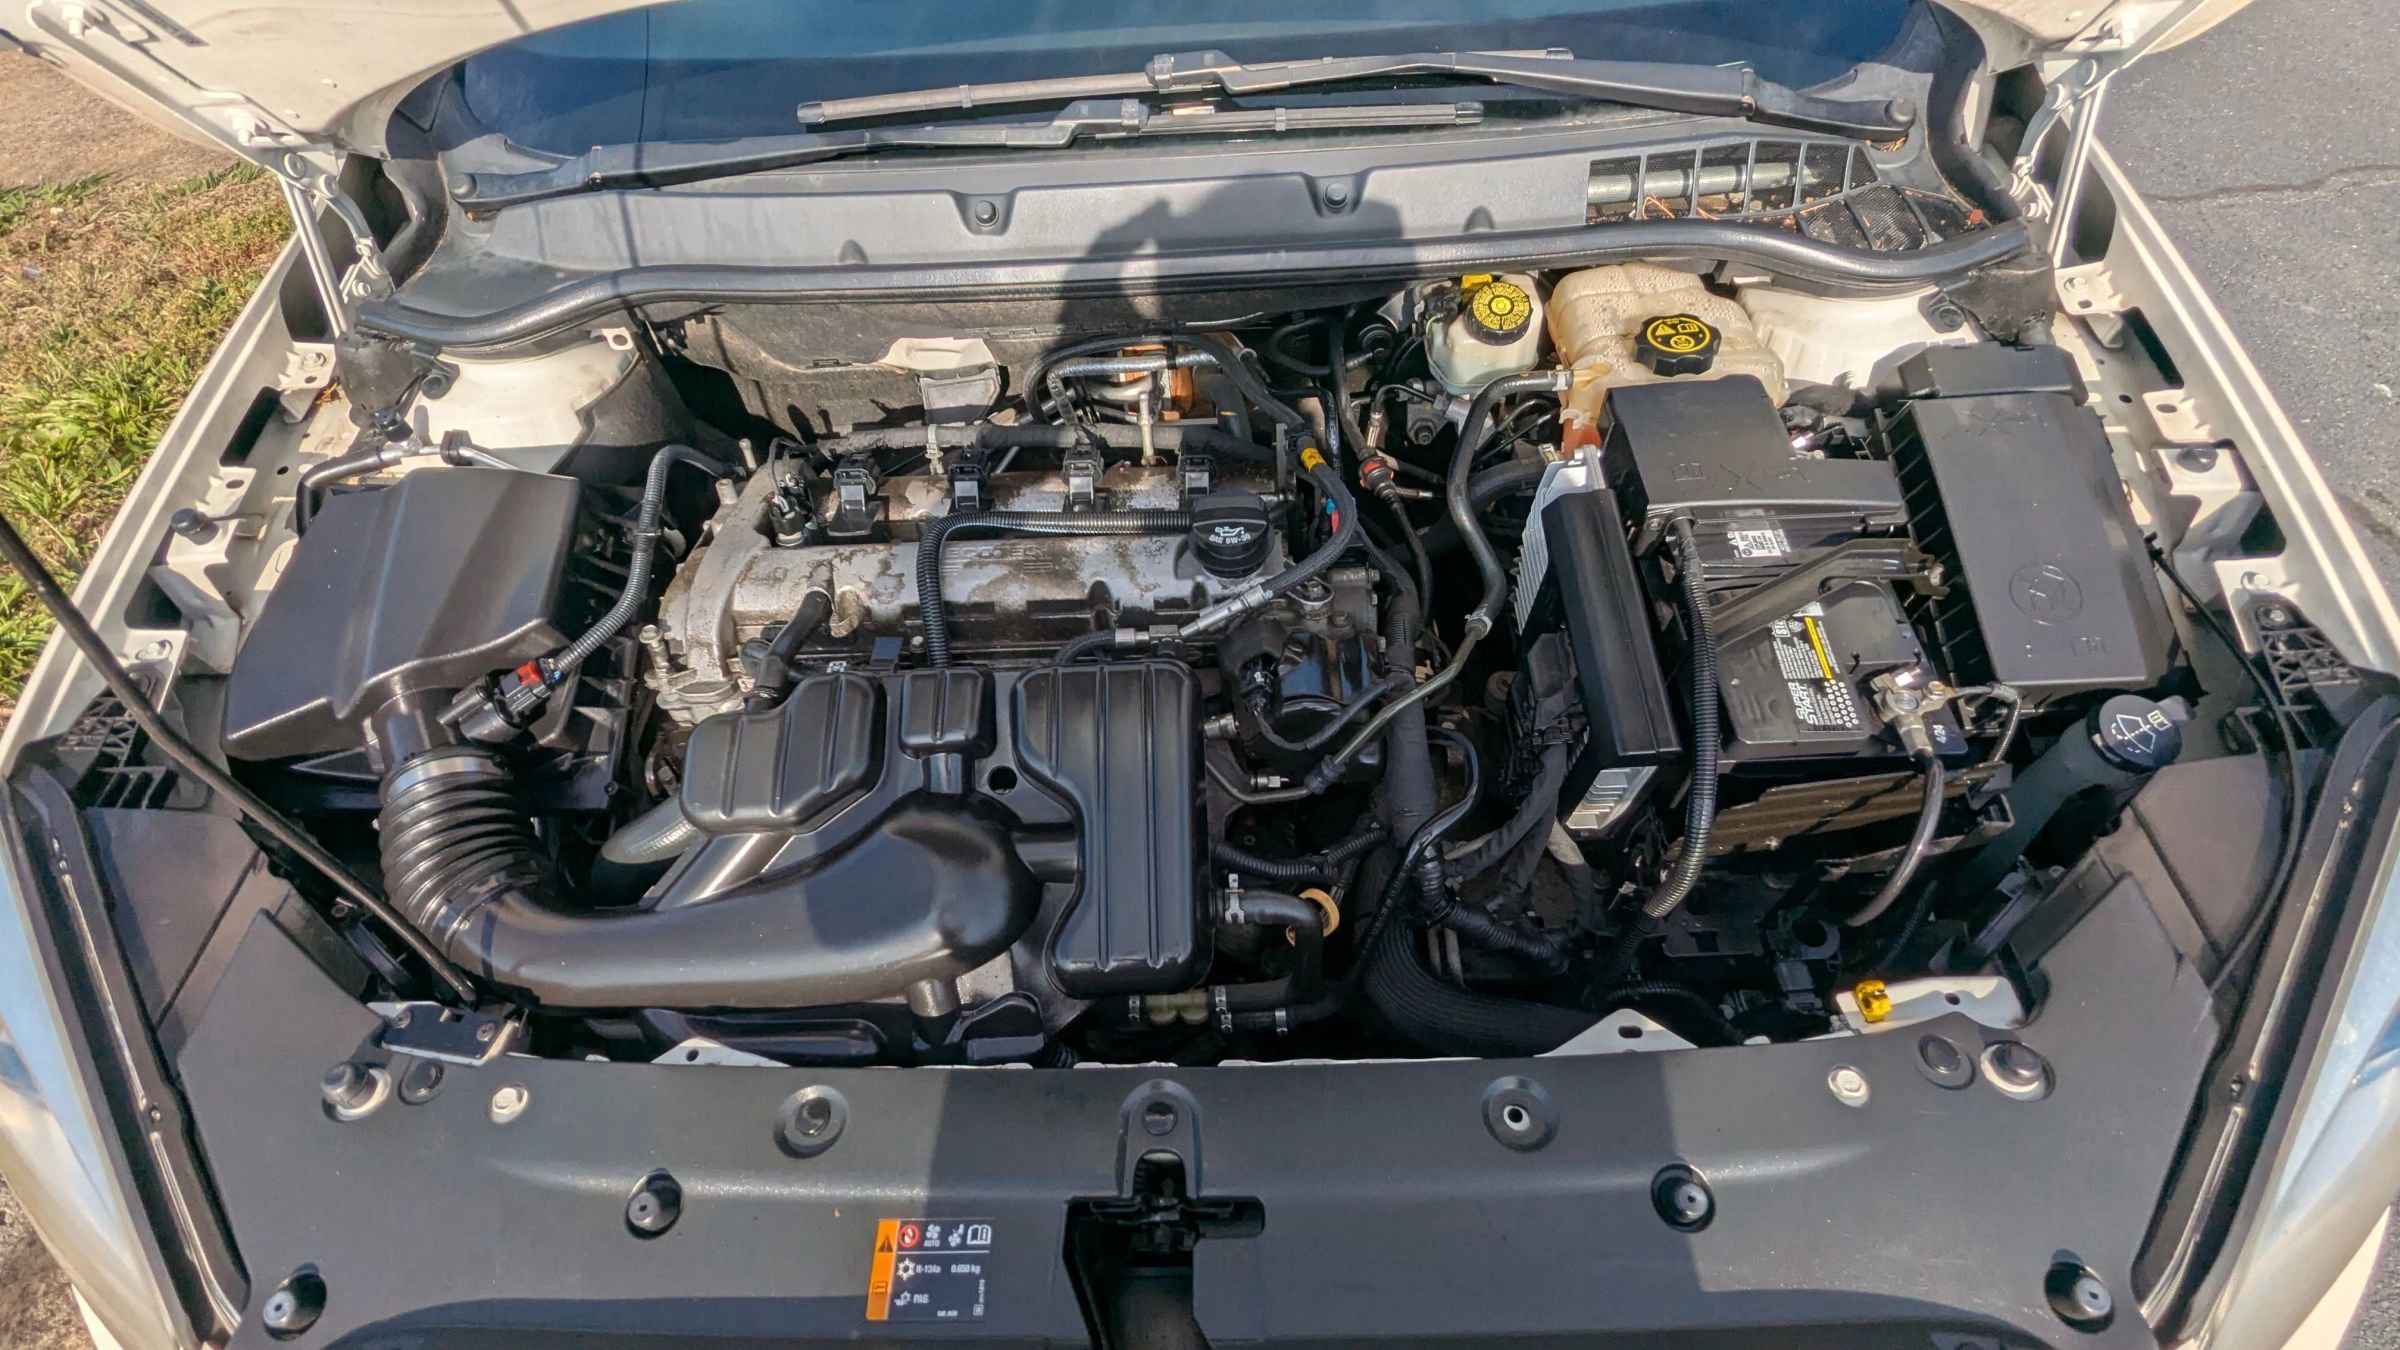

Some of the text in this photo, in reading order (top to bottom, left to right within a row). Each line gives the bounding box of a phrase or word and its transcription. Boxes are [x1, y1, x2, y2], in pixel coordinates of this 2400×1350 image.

[1208, 534, 1224, 544] SAE
[1787, 681, 1807, 720] SUPER
[913, 1294, 929, 1304] PAG
